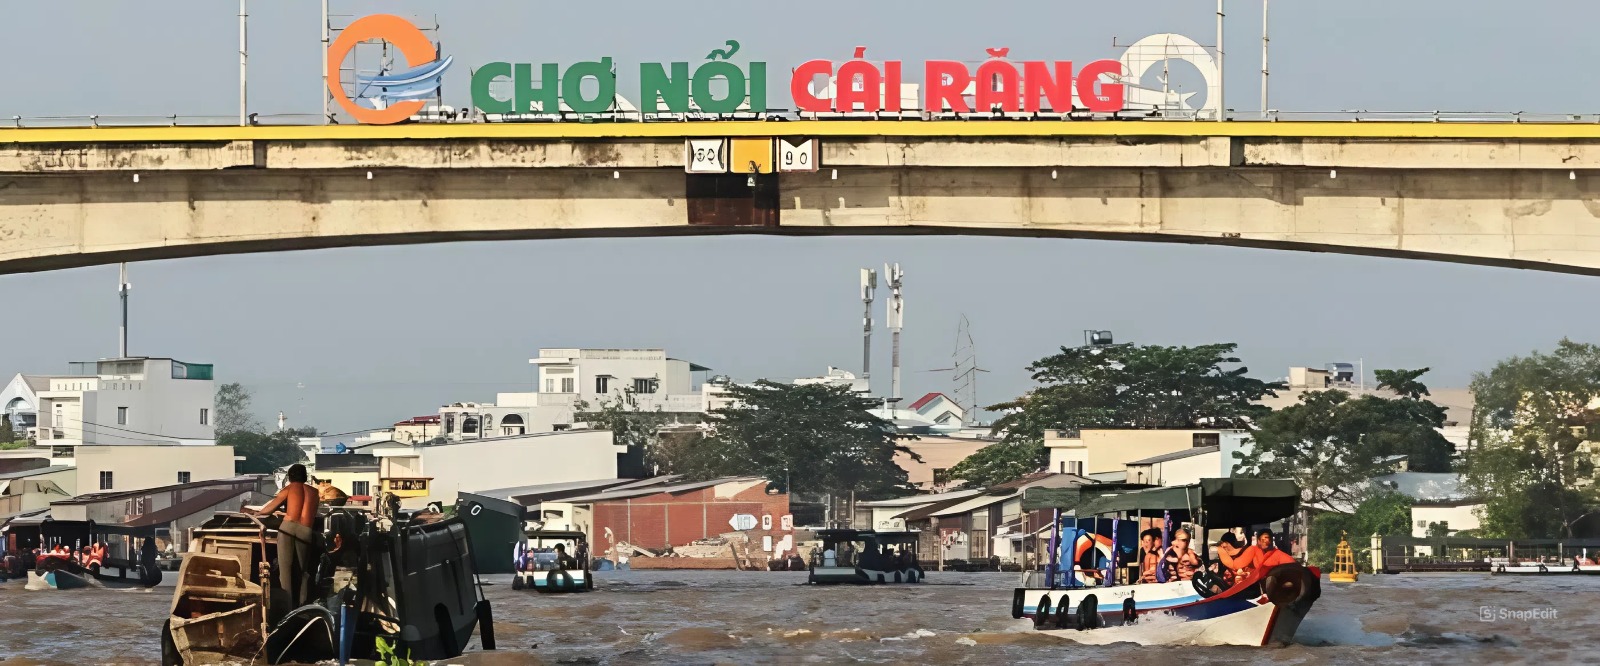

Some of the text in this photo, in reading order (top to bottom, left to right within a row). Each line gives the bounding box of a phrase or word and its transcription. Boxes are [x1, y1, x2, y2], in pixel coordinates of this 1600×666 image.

[640, 39, 767, 114] NỔI
[790, 45, 902, 113] CÁI
[925, 46, 1125, 113] RĂNG
